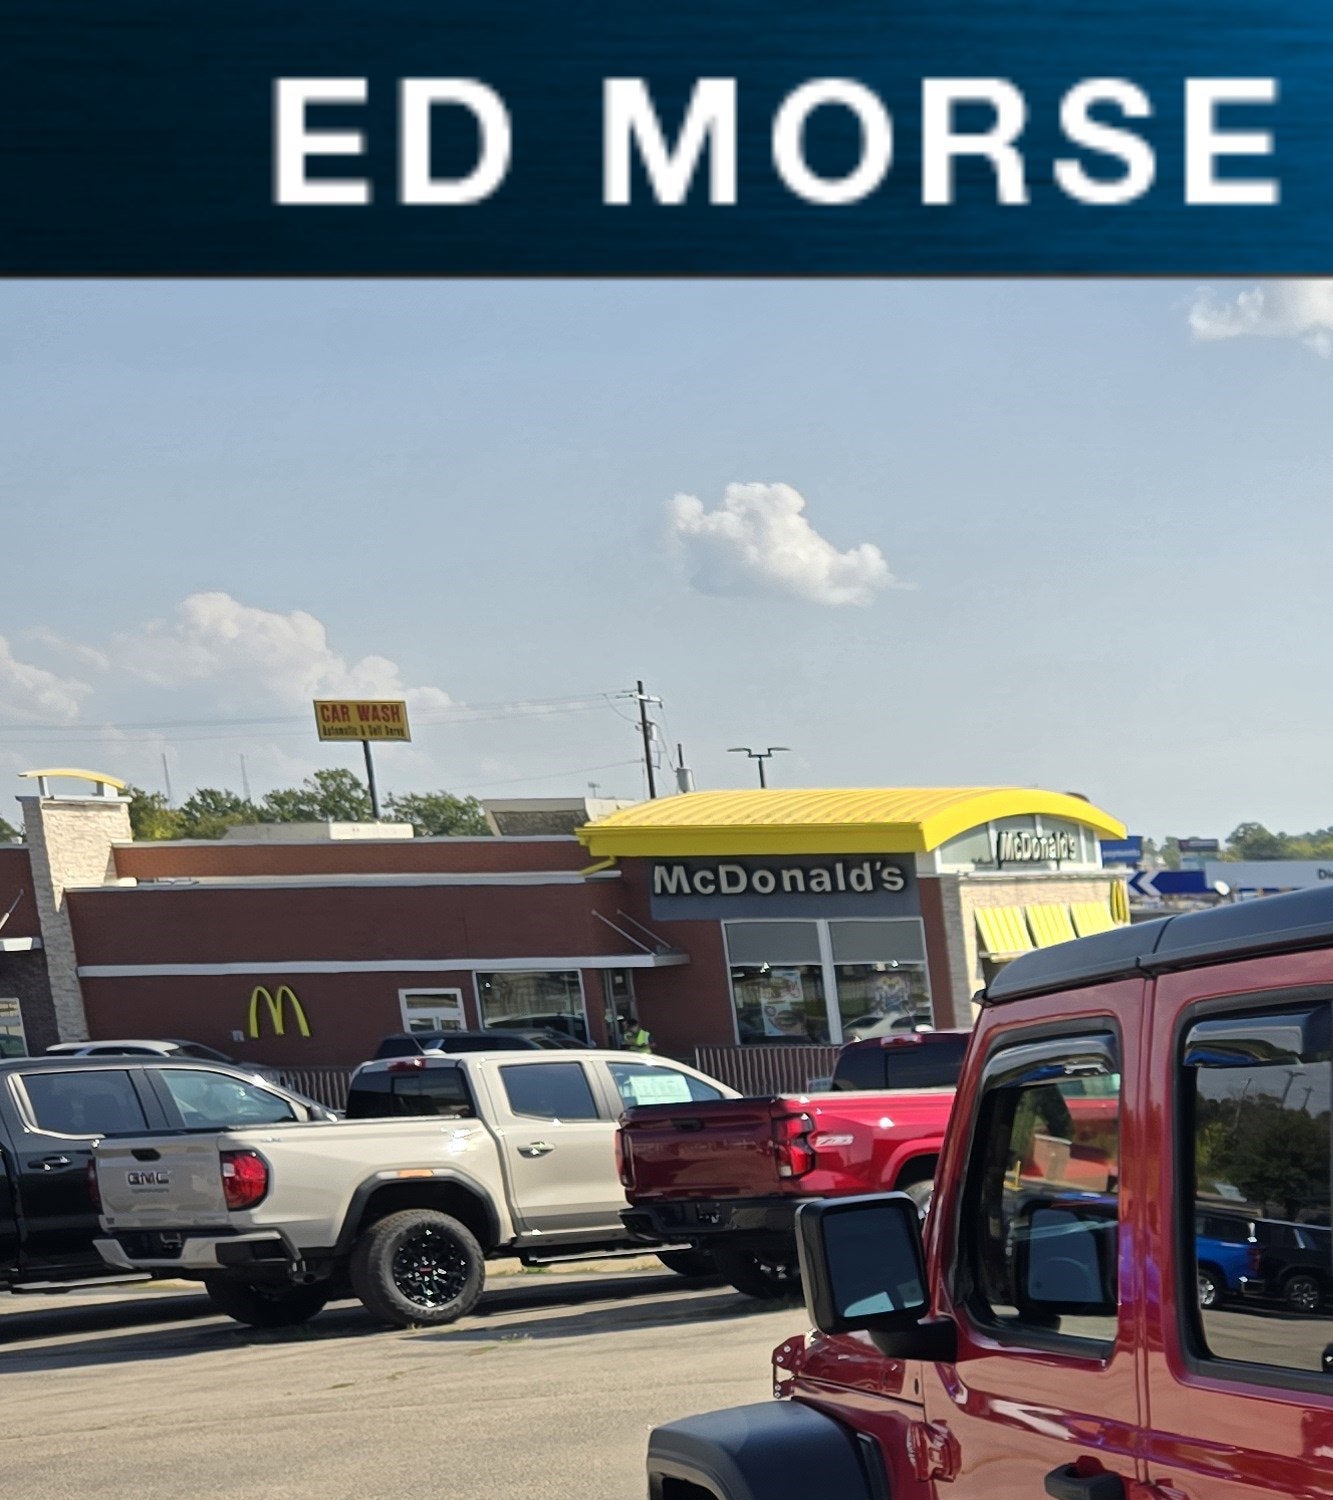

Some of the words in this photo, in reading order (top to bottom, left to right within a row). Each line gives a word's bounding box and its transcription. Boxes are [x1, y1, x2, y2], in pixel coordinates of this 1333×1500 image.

[320, 704, 350, 722] CAR
[357, 704, 401, 722] WASH
[998, 831, 1077, 861] McDonald's
[653, 862, 905, 895] McDonald's
[127, 1171, 170, 1186] GMC
